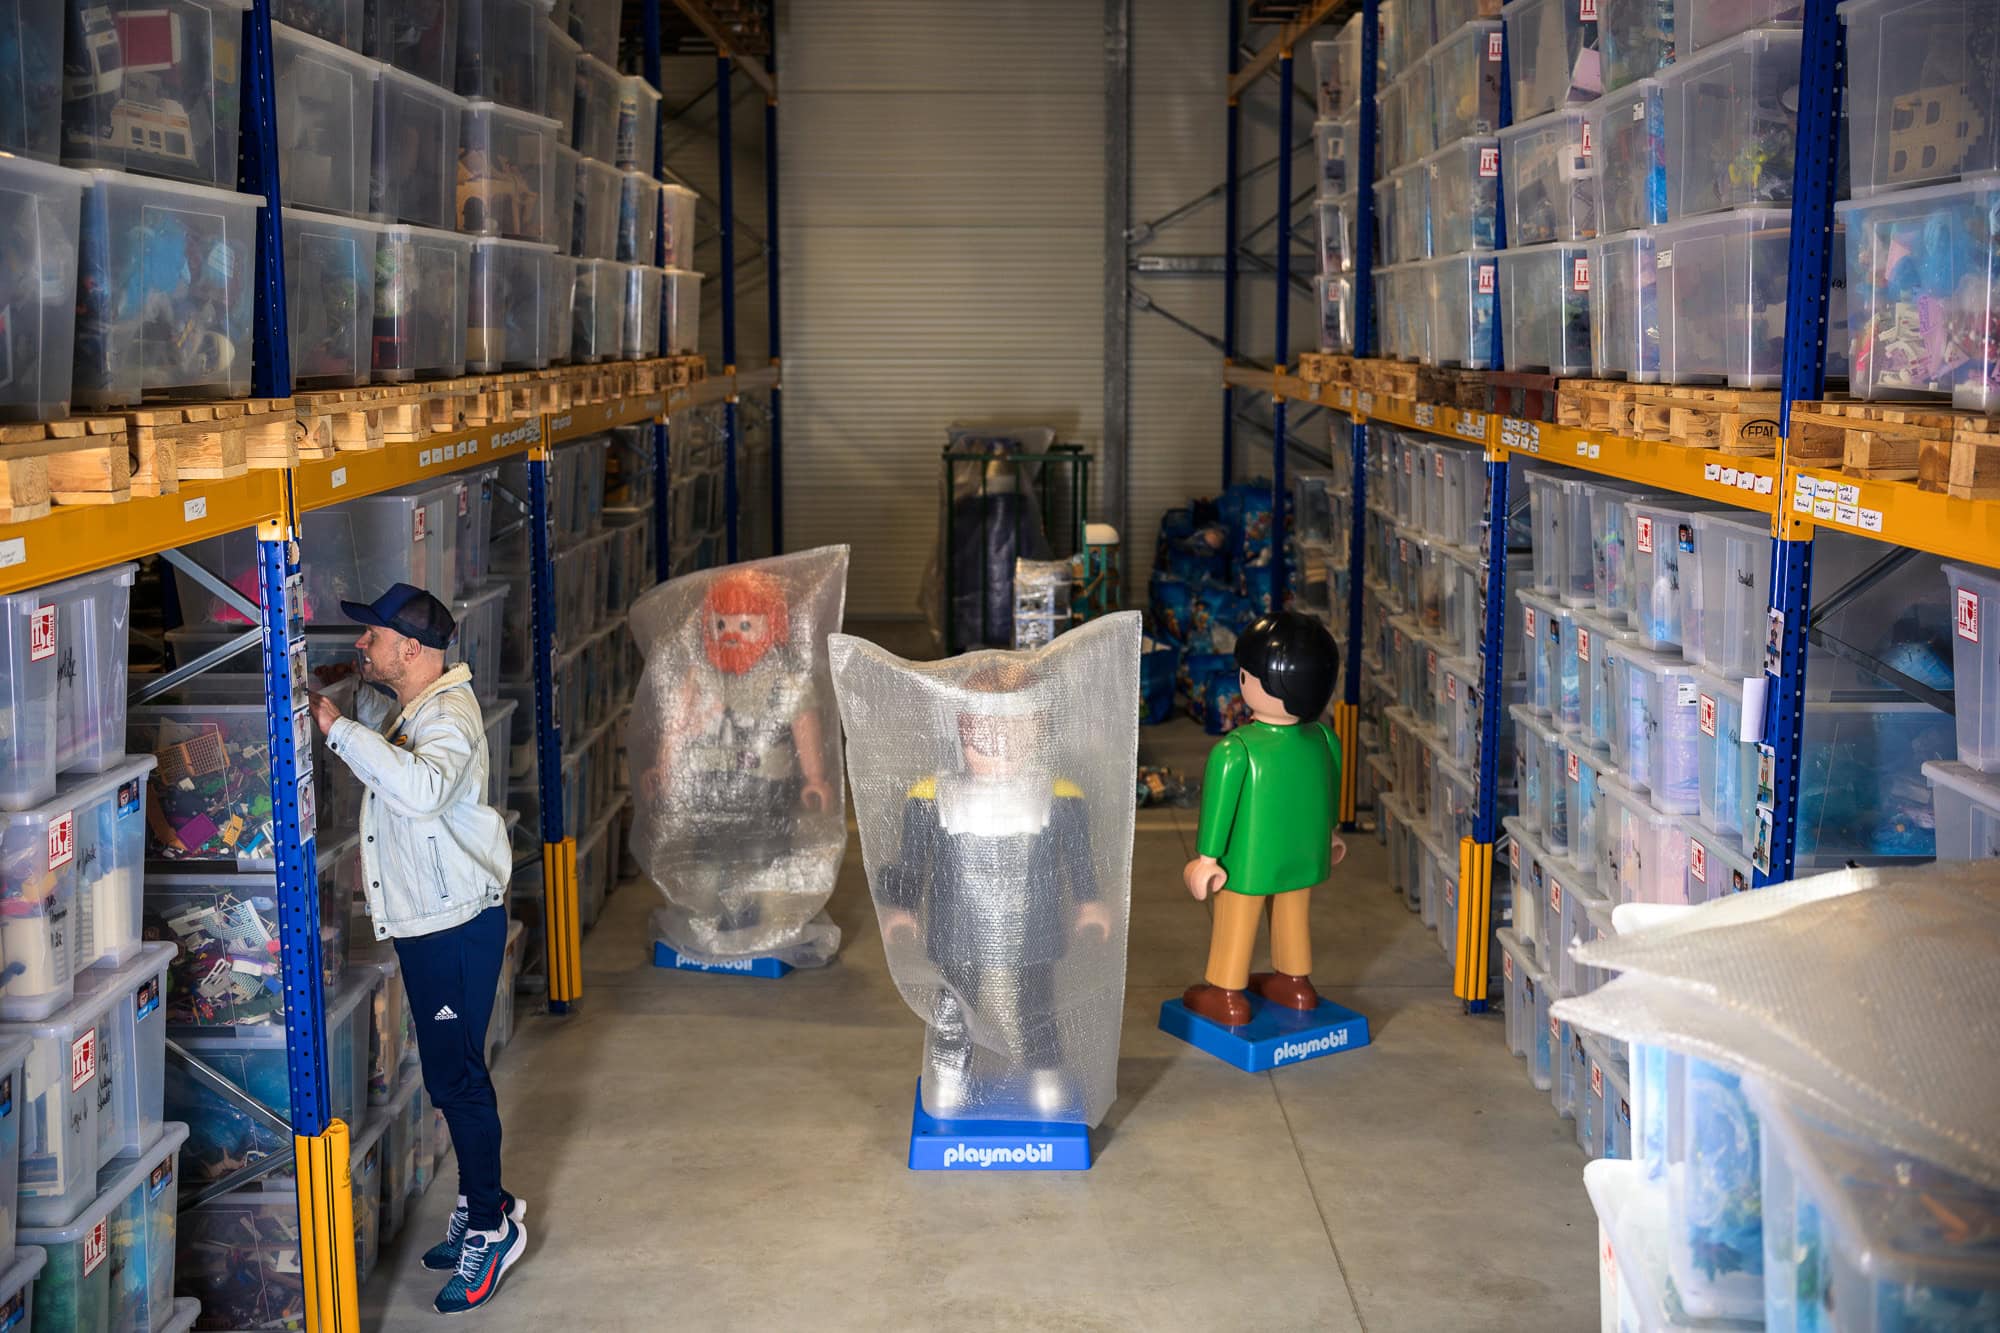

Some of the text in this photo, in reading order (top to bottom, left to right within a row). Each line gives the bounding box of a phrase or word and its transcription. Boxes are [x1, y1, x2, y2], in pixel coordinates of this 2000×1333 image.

[434, 1013, 458, 1021] adidas
[1273, 1028, 1349, 1066] playmobil
[943, 1143, 1053, 1168] playmobil
